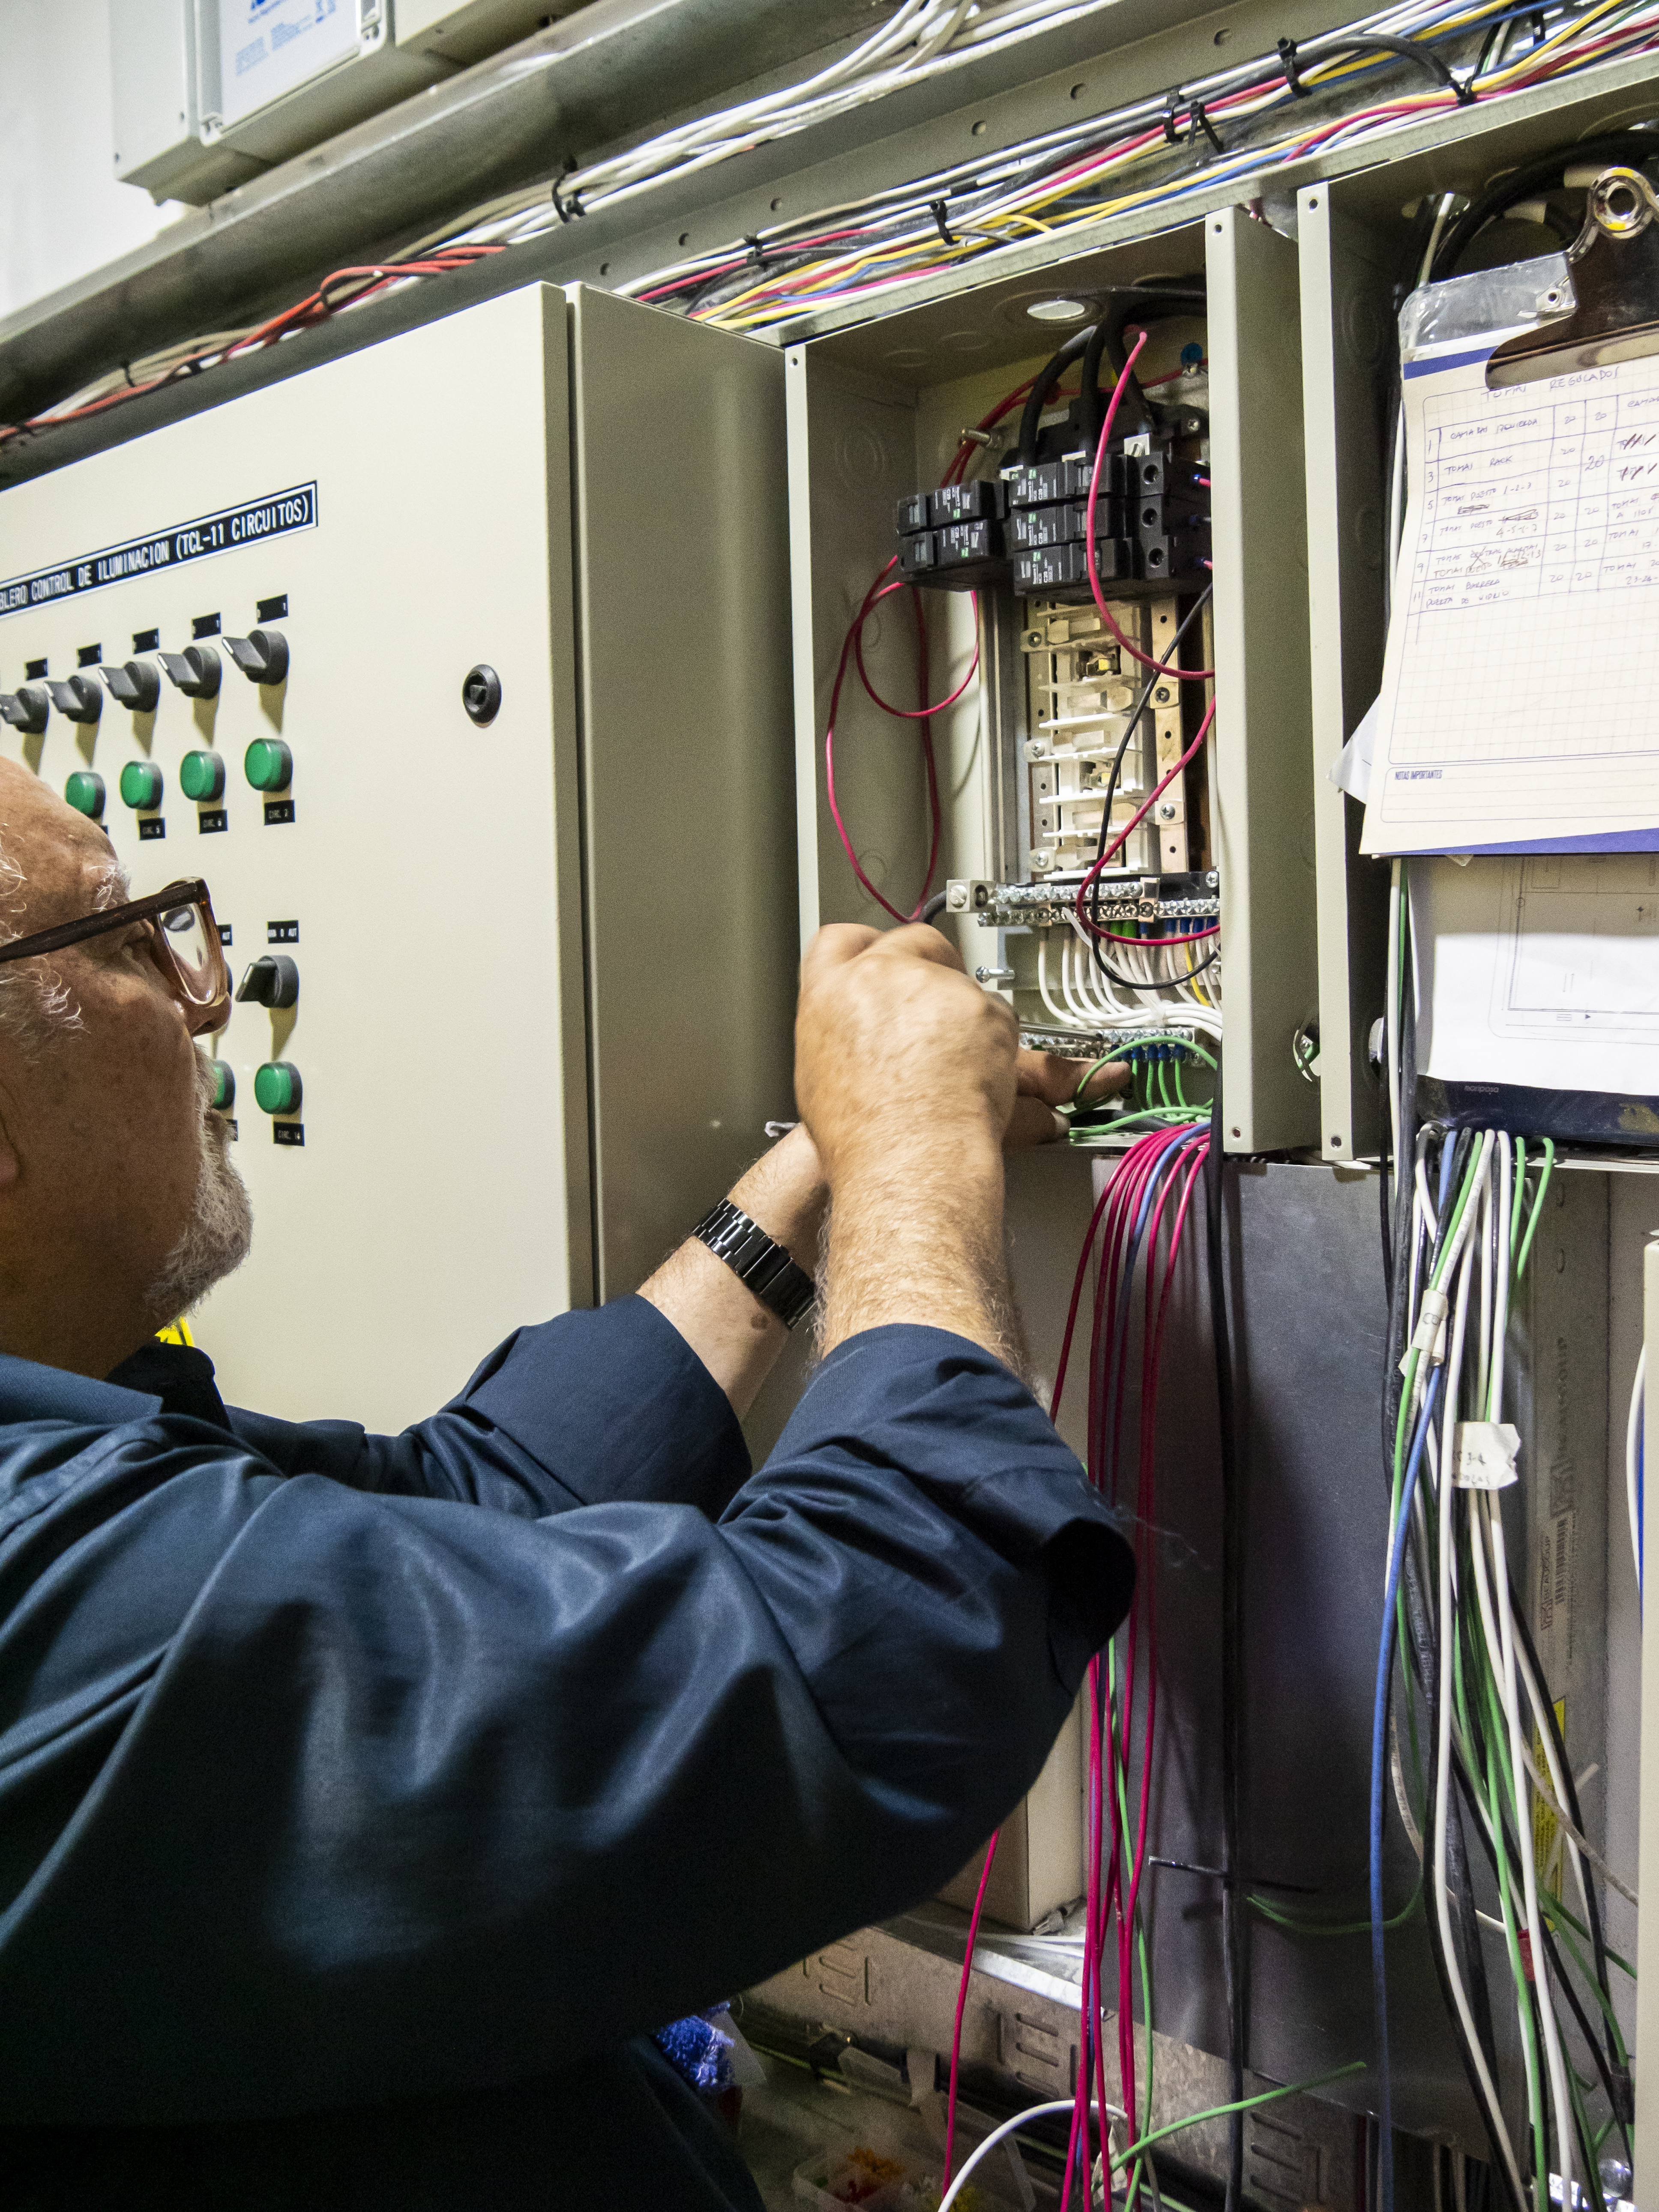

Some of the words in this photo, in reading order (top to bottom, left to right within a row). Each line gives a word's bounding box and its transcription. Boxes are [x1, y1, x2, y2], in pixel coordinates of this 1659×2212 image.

[1550, 366, 1620, 391] REGULADOS
[1564, 416, 1576, 425] 20
[1595, 412, 1607, 421] 20
[1428, 440, 1432, 454] 1
[1444, 463, 1473, 475] TOMAS
[1489, 455, 1513, 467] RACK
[1584, 455, 1605, 471] 20
[1428, 471, 1434, 483] 3
[1558, 479, 1571, 488] 20
[1428, 500, 1434, 510] 5
[1584, 507, 1600, 515] 20
[1422, 534, 1428, 543] 7
[1584, 539, 1599, 548] 20
[31, 571, 75, 601] CONTROL
[77, 564, 93, 587] DE
[97, 539, 170, 581] ILUMINACION
[175, 522, 224, 560] (TCL-11
[231, 494, 308, 542] CIRCUITOS)
[1417, 563, 1424, 573] 9
[1549, 574, 1564, 582] 20
[1575, 572, 1592, 581] 20
[1395, 771, 1410, 780] NOTAS
[1410, 770, 1443, 779] IMPORTANTES
